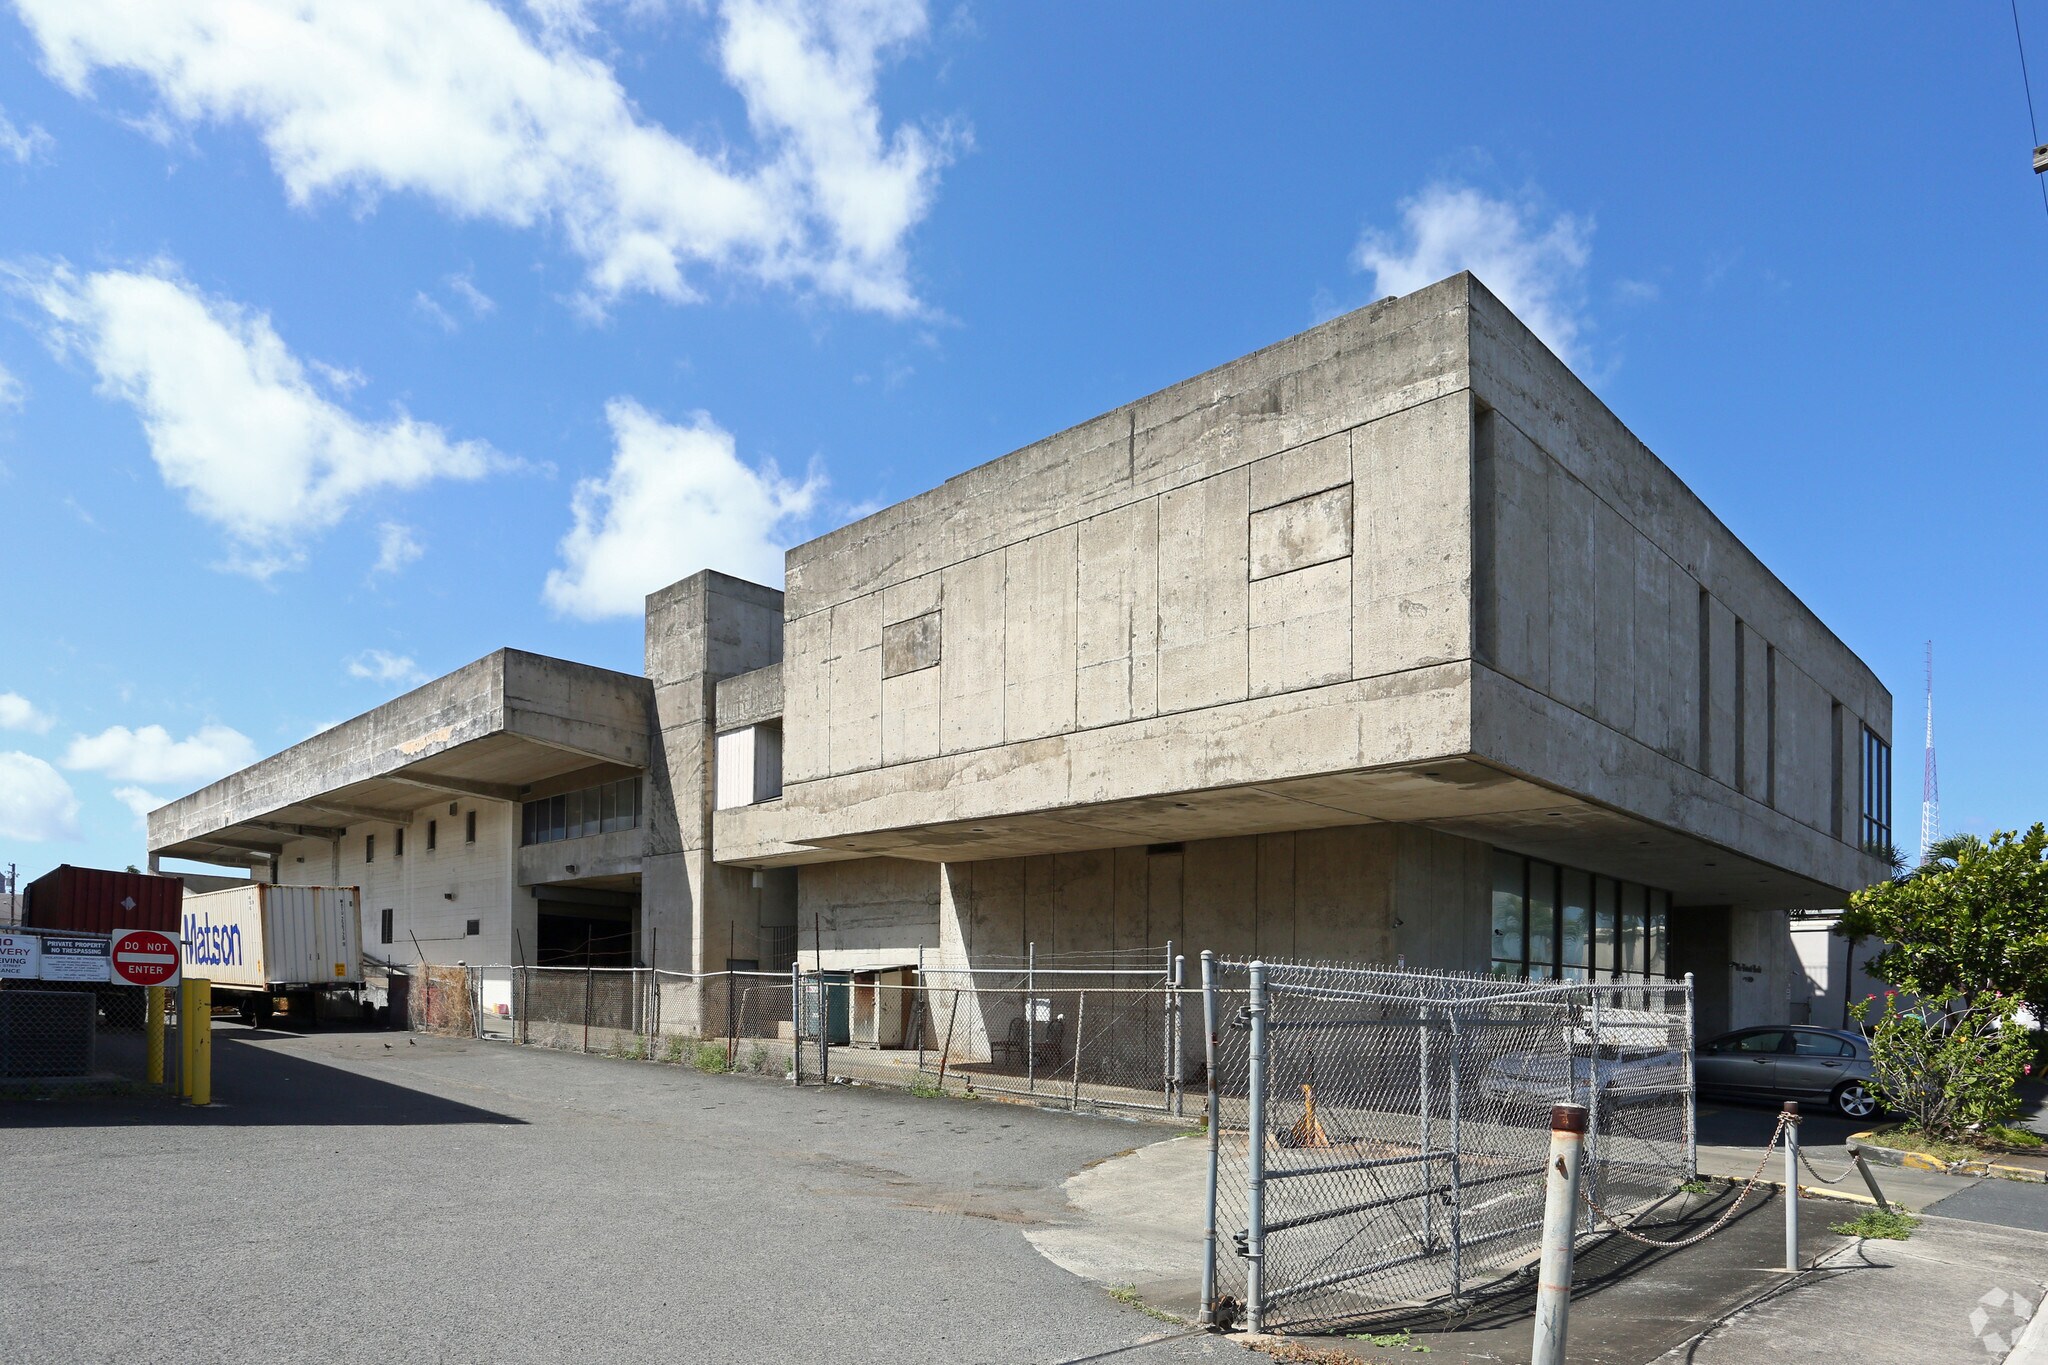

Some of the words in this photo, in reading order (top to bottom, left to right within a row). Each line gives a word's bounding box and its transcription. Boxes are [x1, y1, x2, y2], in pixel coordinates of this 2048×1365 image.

[0, 938, 13, 946] O
[183, 911, 242, 966] Matson
[124, 941, 139, 950] DO
[147, 942, 168, 952] NOT
[128, 965, 163, 975] ENTER
